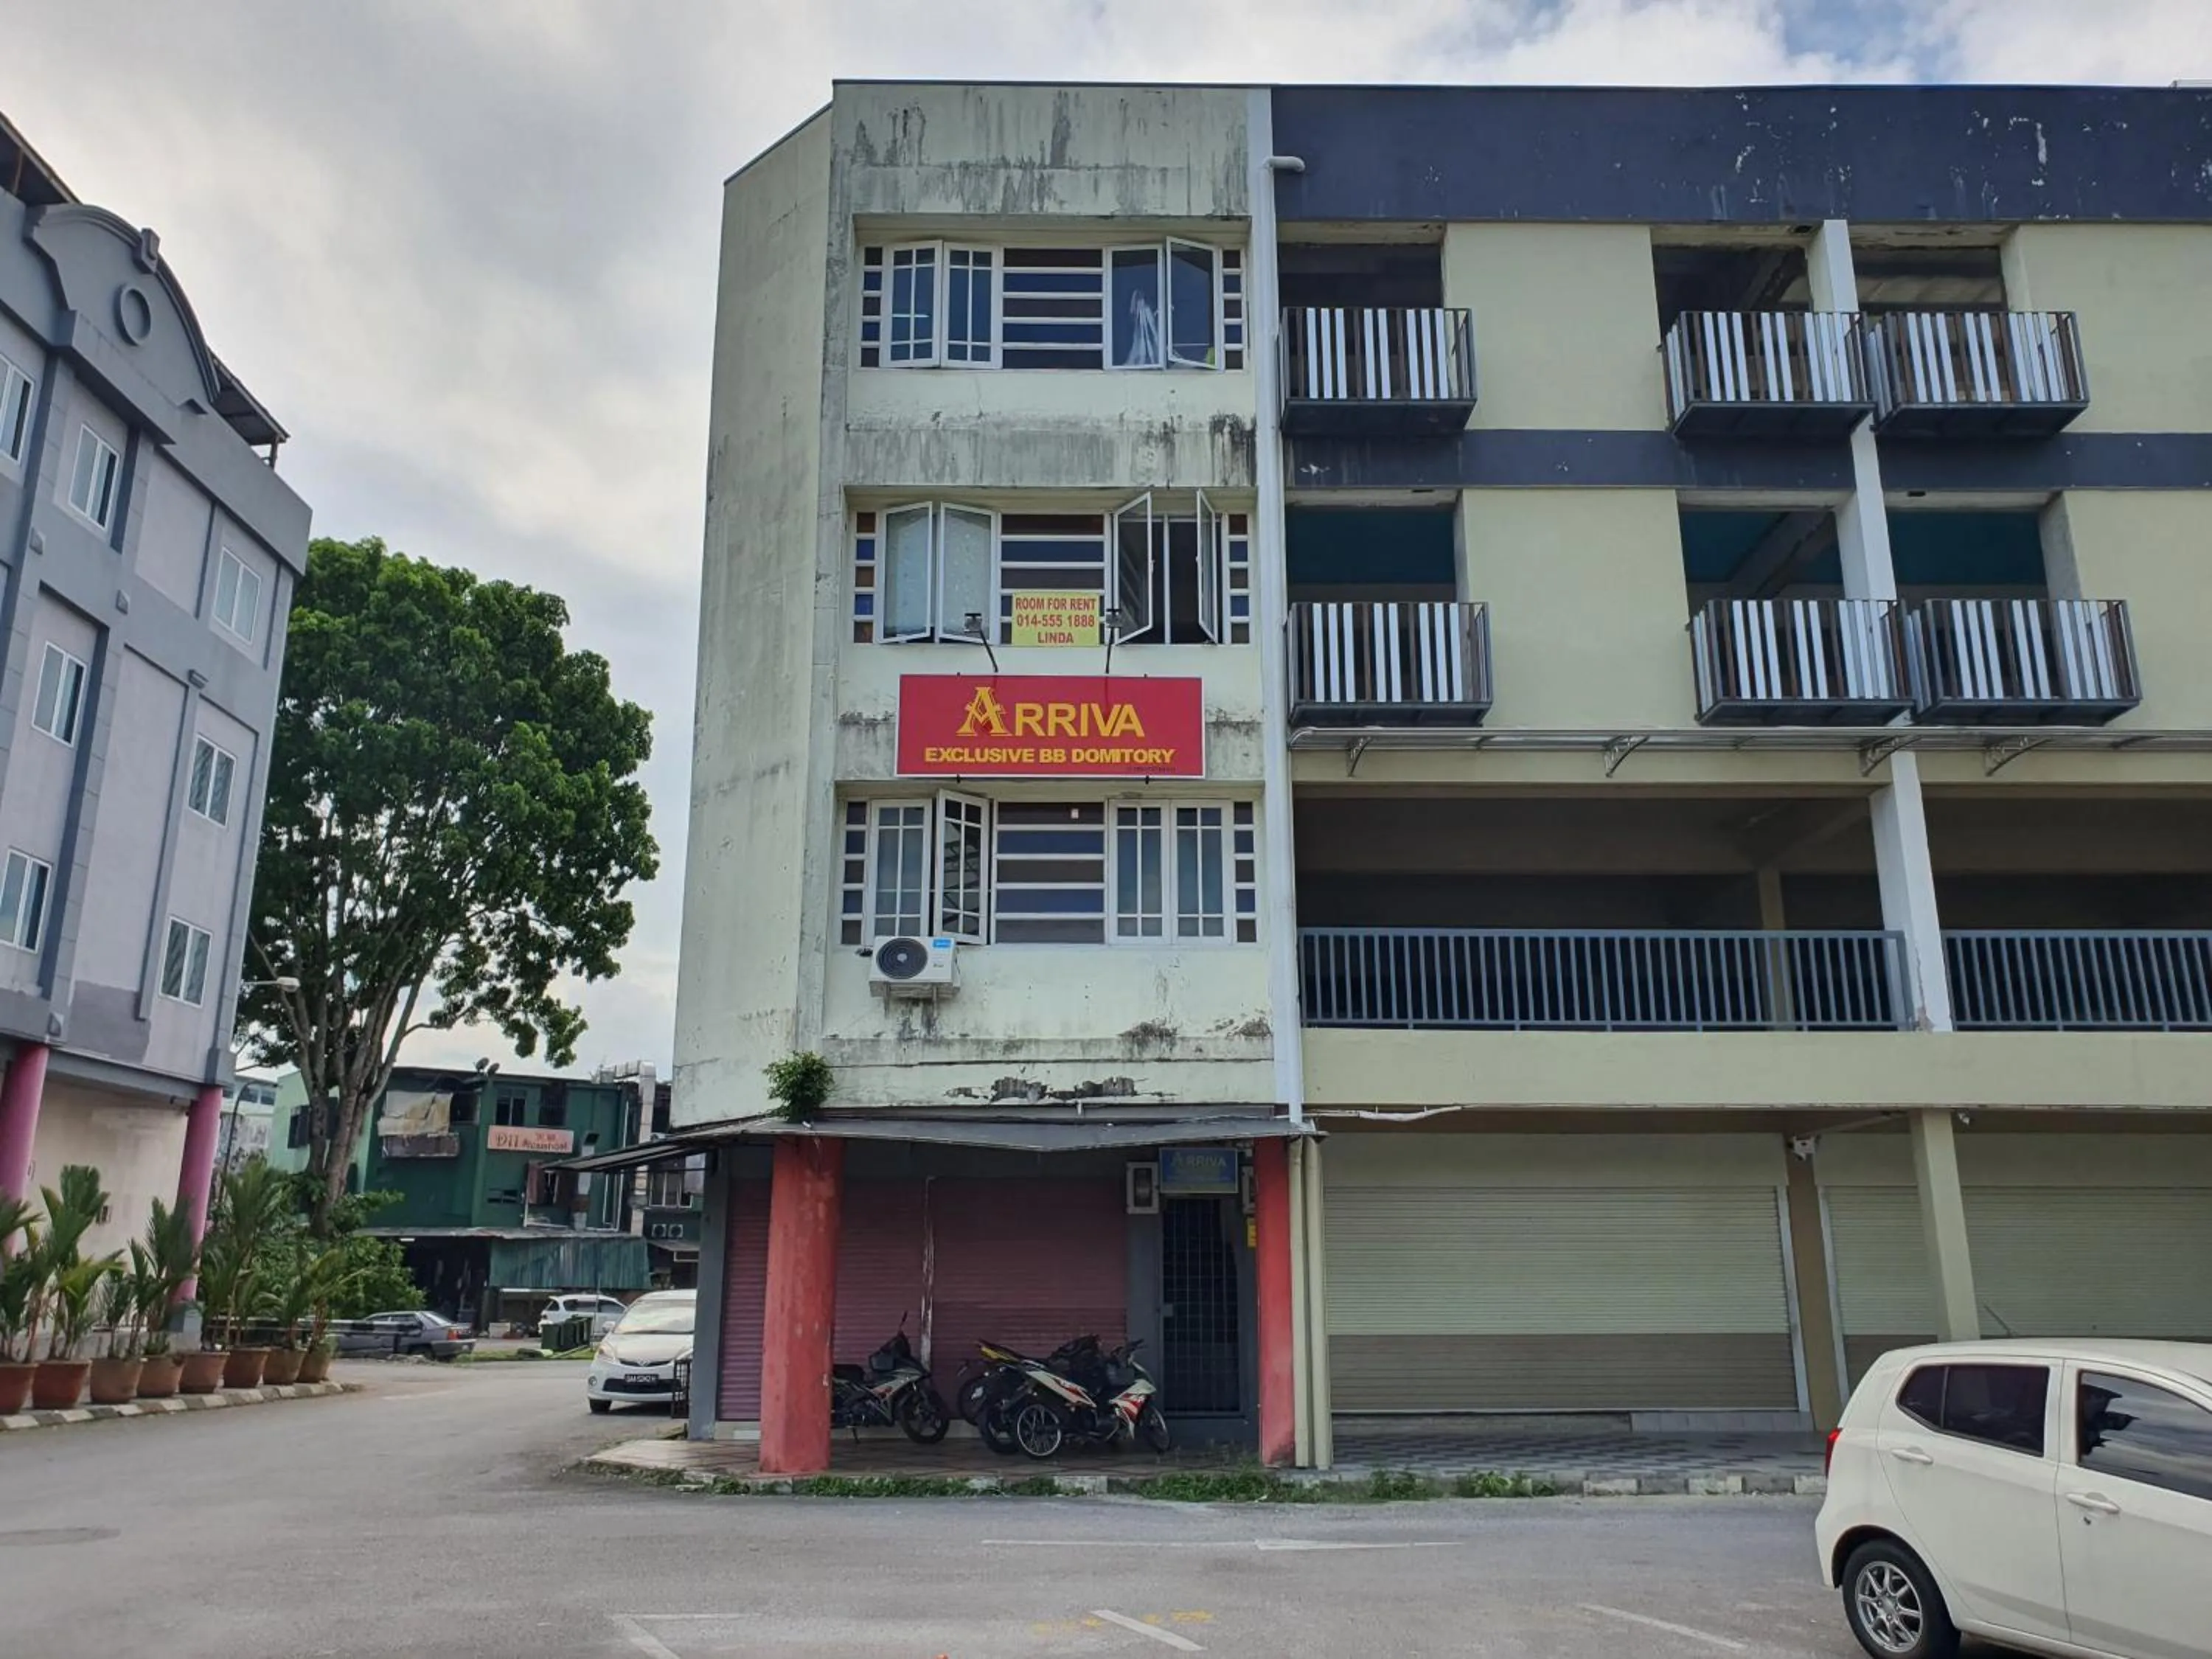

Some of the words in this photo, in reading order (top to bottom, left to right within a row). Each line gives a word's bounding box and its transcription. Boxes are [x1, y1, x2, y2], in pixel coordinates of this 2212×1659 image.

[1015, 598, 1045, 611] ROOM
[1048, 598, 1067, 611] FOR
[1070, 598, 1096, 611] RENT
[1017, 614, 1062, 627] 014-555
[1067, 614, 1095, 627] 1888
[1037, 632, 1074, 644] LINDA
[956, 686, 1145, 737] ARRIVA
[925, 748, 1034, 762] EXCLUSIVE
[1039, 749, 1066, 763] BB
[1071, 749, 1176, 763] DOMITORY
[1170, 1152, 1227, 1169] ARRIVA
